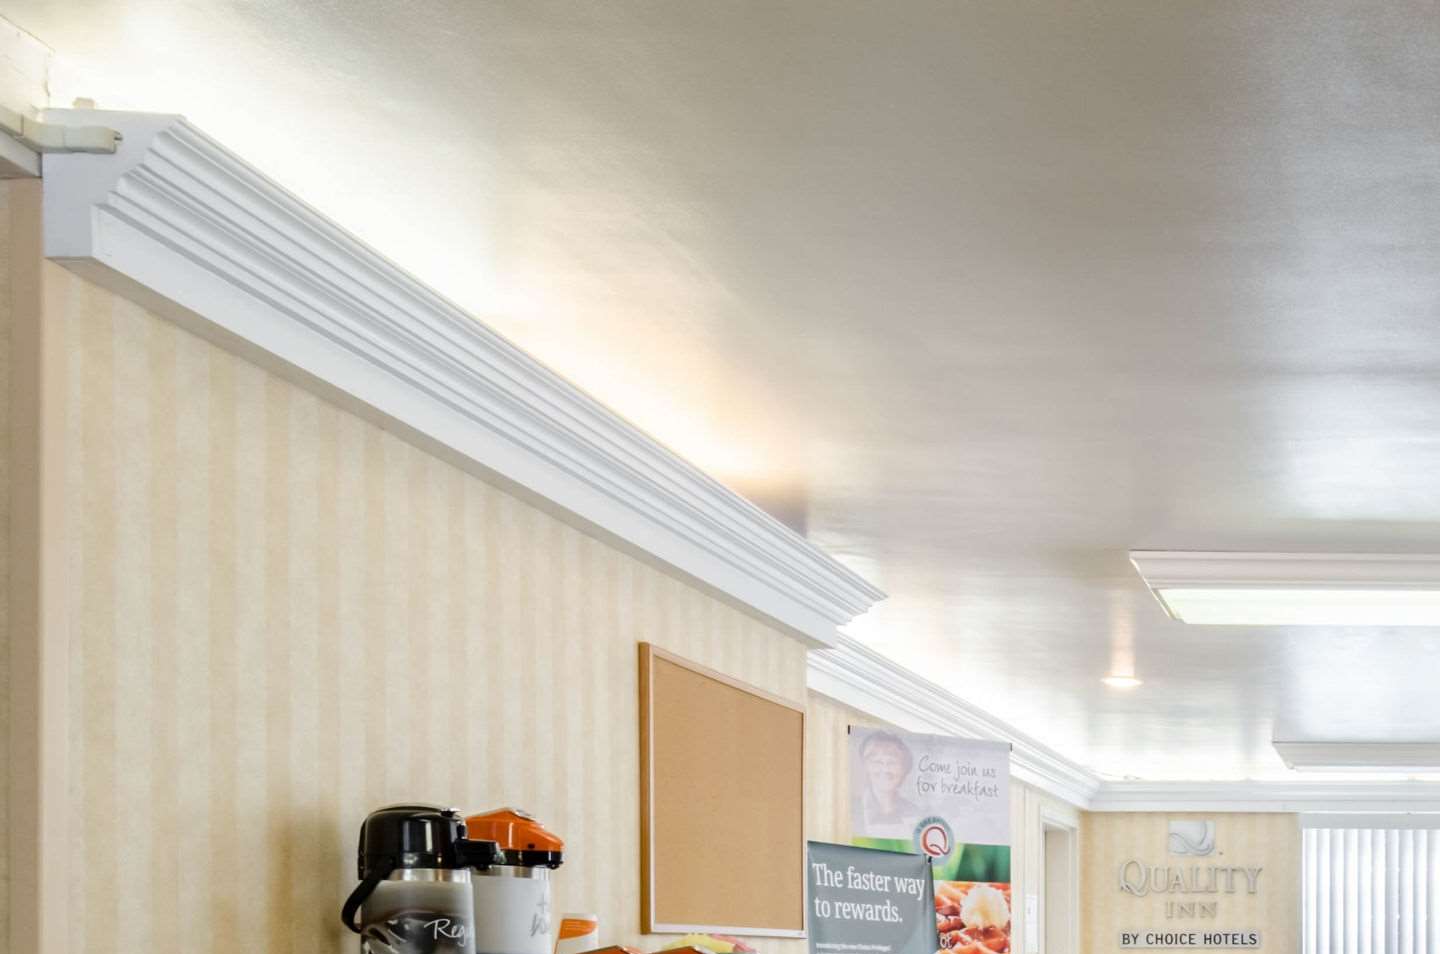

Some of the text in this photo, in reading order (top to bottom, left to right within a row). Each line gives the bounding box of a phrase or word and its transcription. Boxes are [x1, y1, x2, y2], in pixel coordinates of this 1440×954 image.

[918, 755, 997, 780] Come join us
[917, 776, 999, 800] for breakfast
[812, 863, 925, 901] The faster way
[814, 898, 903, 923] to rewards.
[1164, 901, 1218, 919] INN
[1121, 933, 1257, 945] BY CHOICE HOTELS
